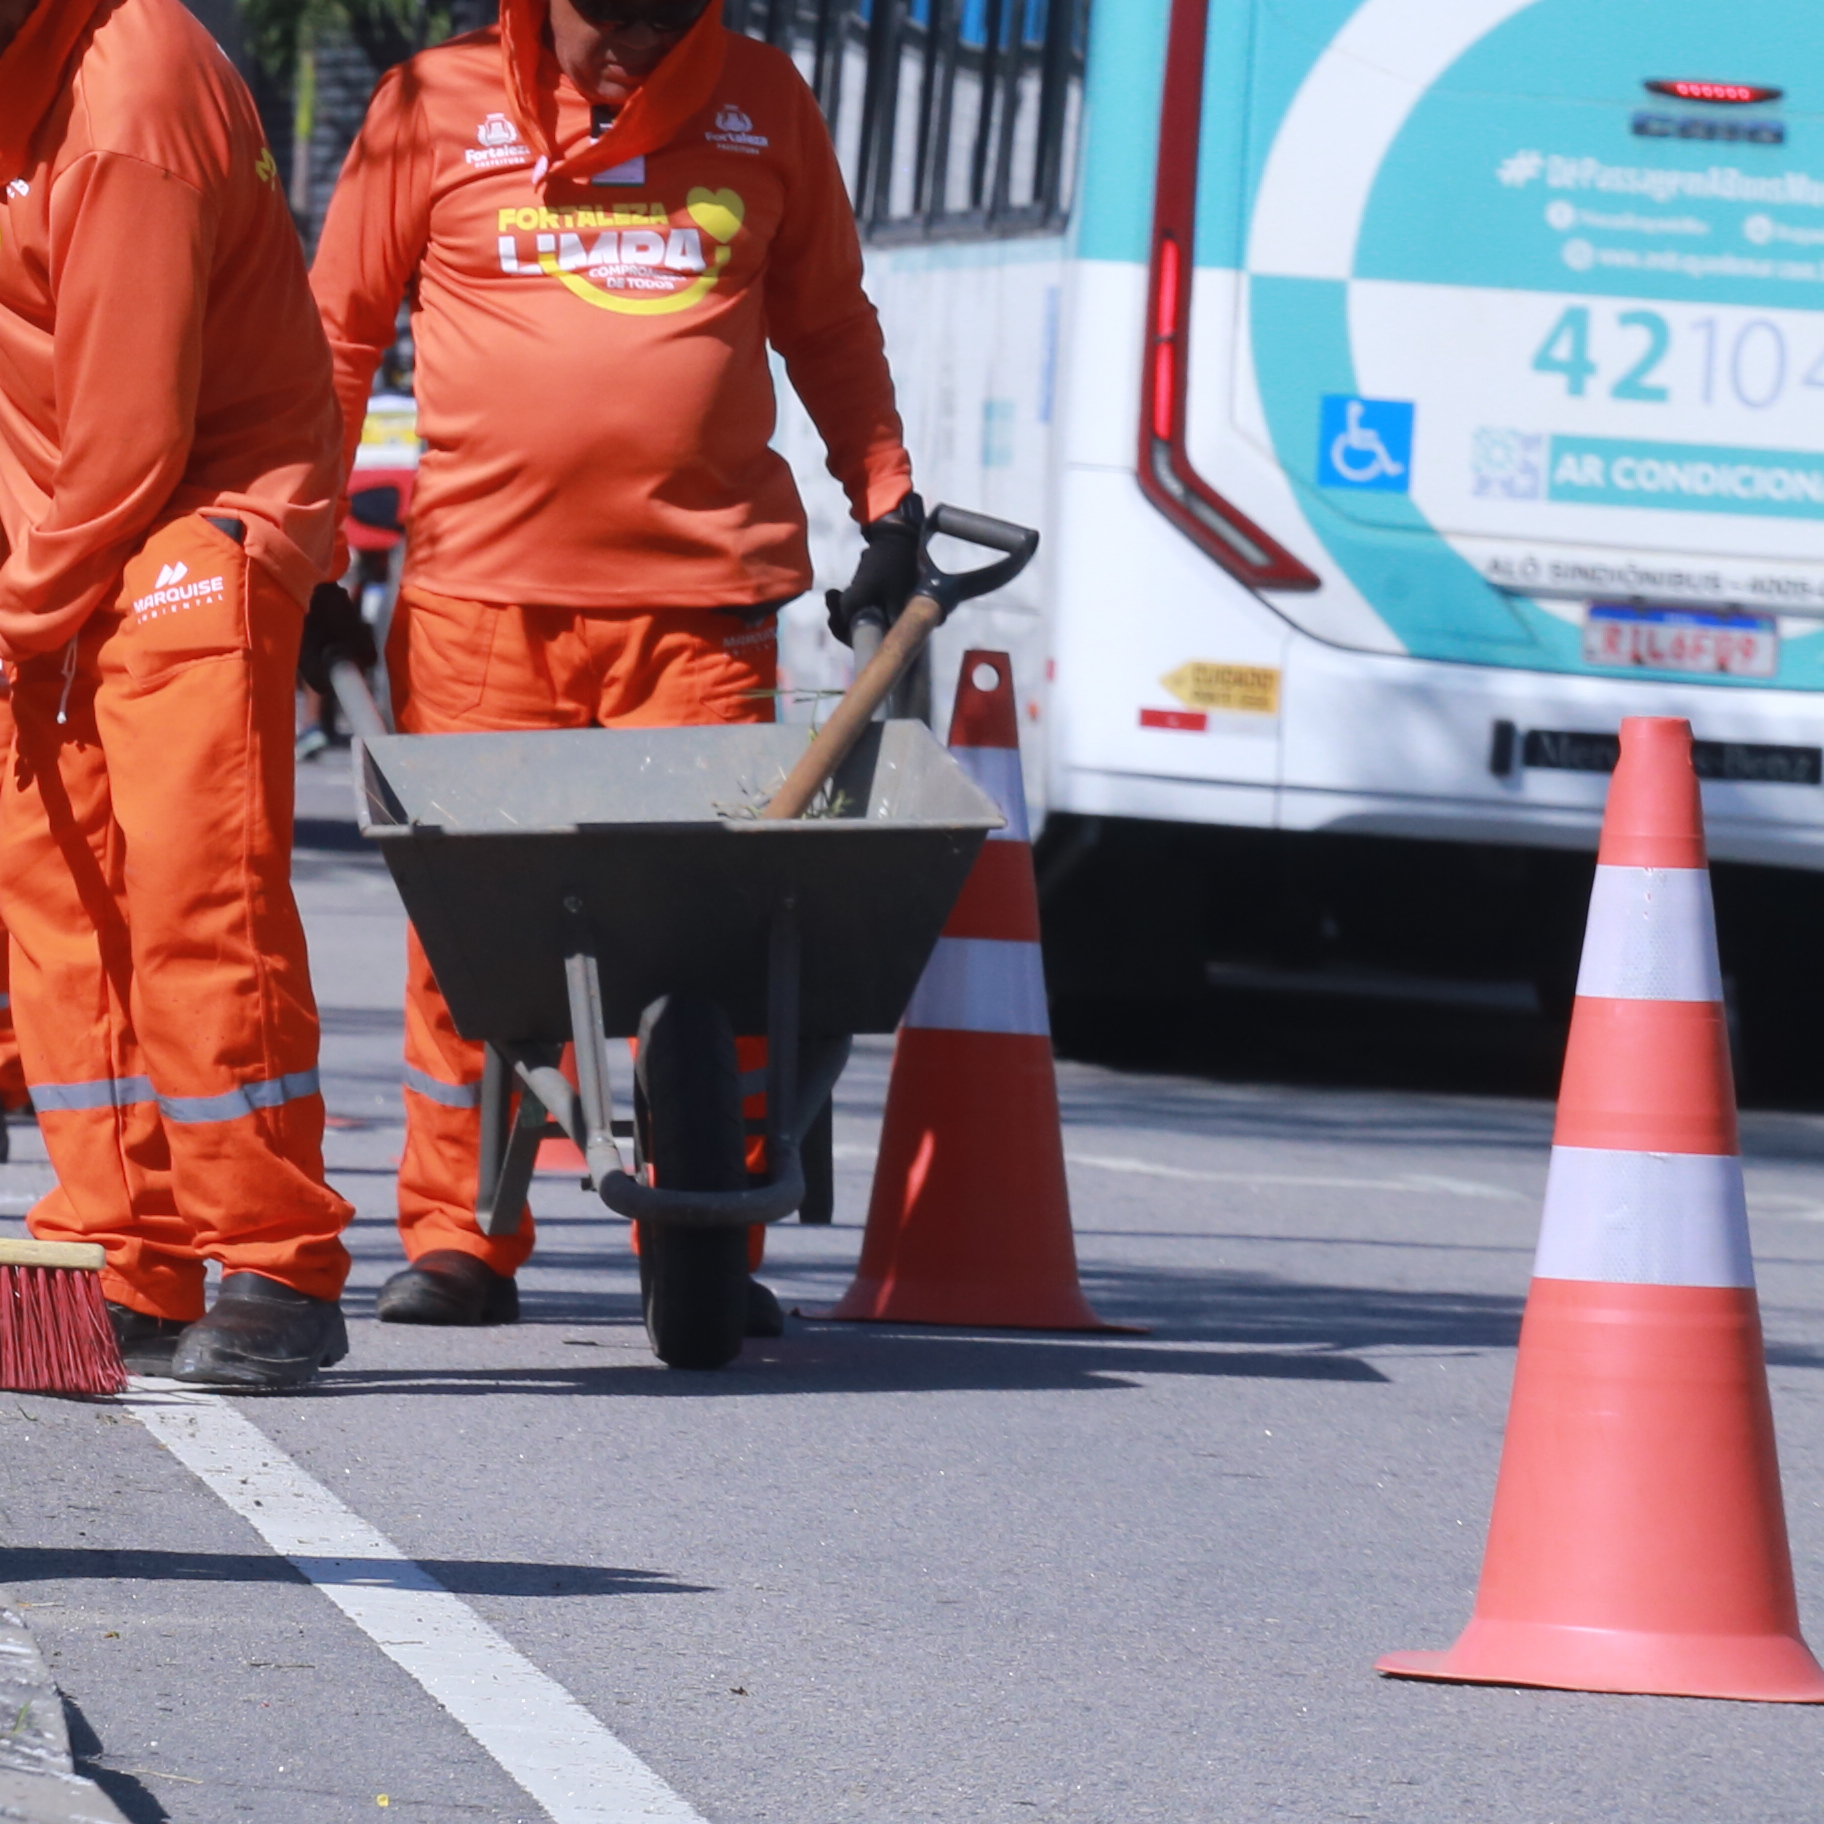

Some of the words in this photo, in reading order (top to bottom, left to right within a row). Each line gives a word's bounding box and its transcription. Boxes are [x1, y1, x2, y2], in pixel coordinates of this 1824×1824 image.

[705, 130, 769, 147] Fortaleza
[497, 202, 670, 232] FORTALEZA
[628, 279, 675, 291] TODOS
[1555, 453, 1605, 487] AR
[133, 576, 224, 614] MARQUISE
